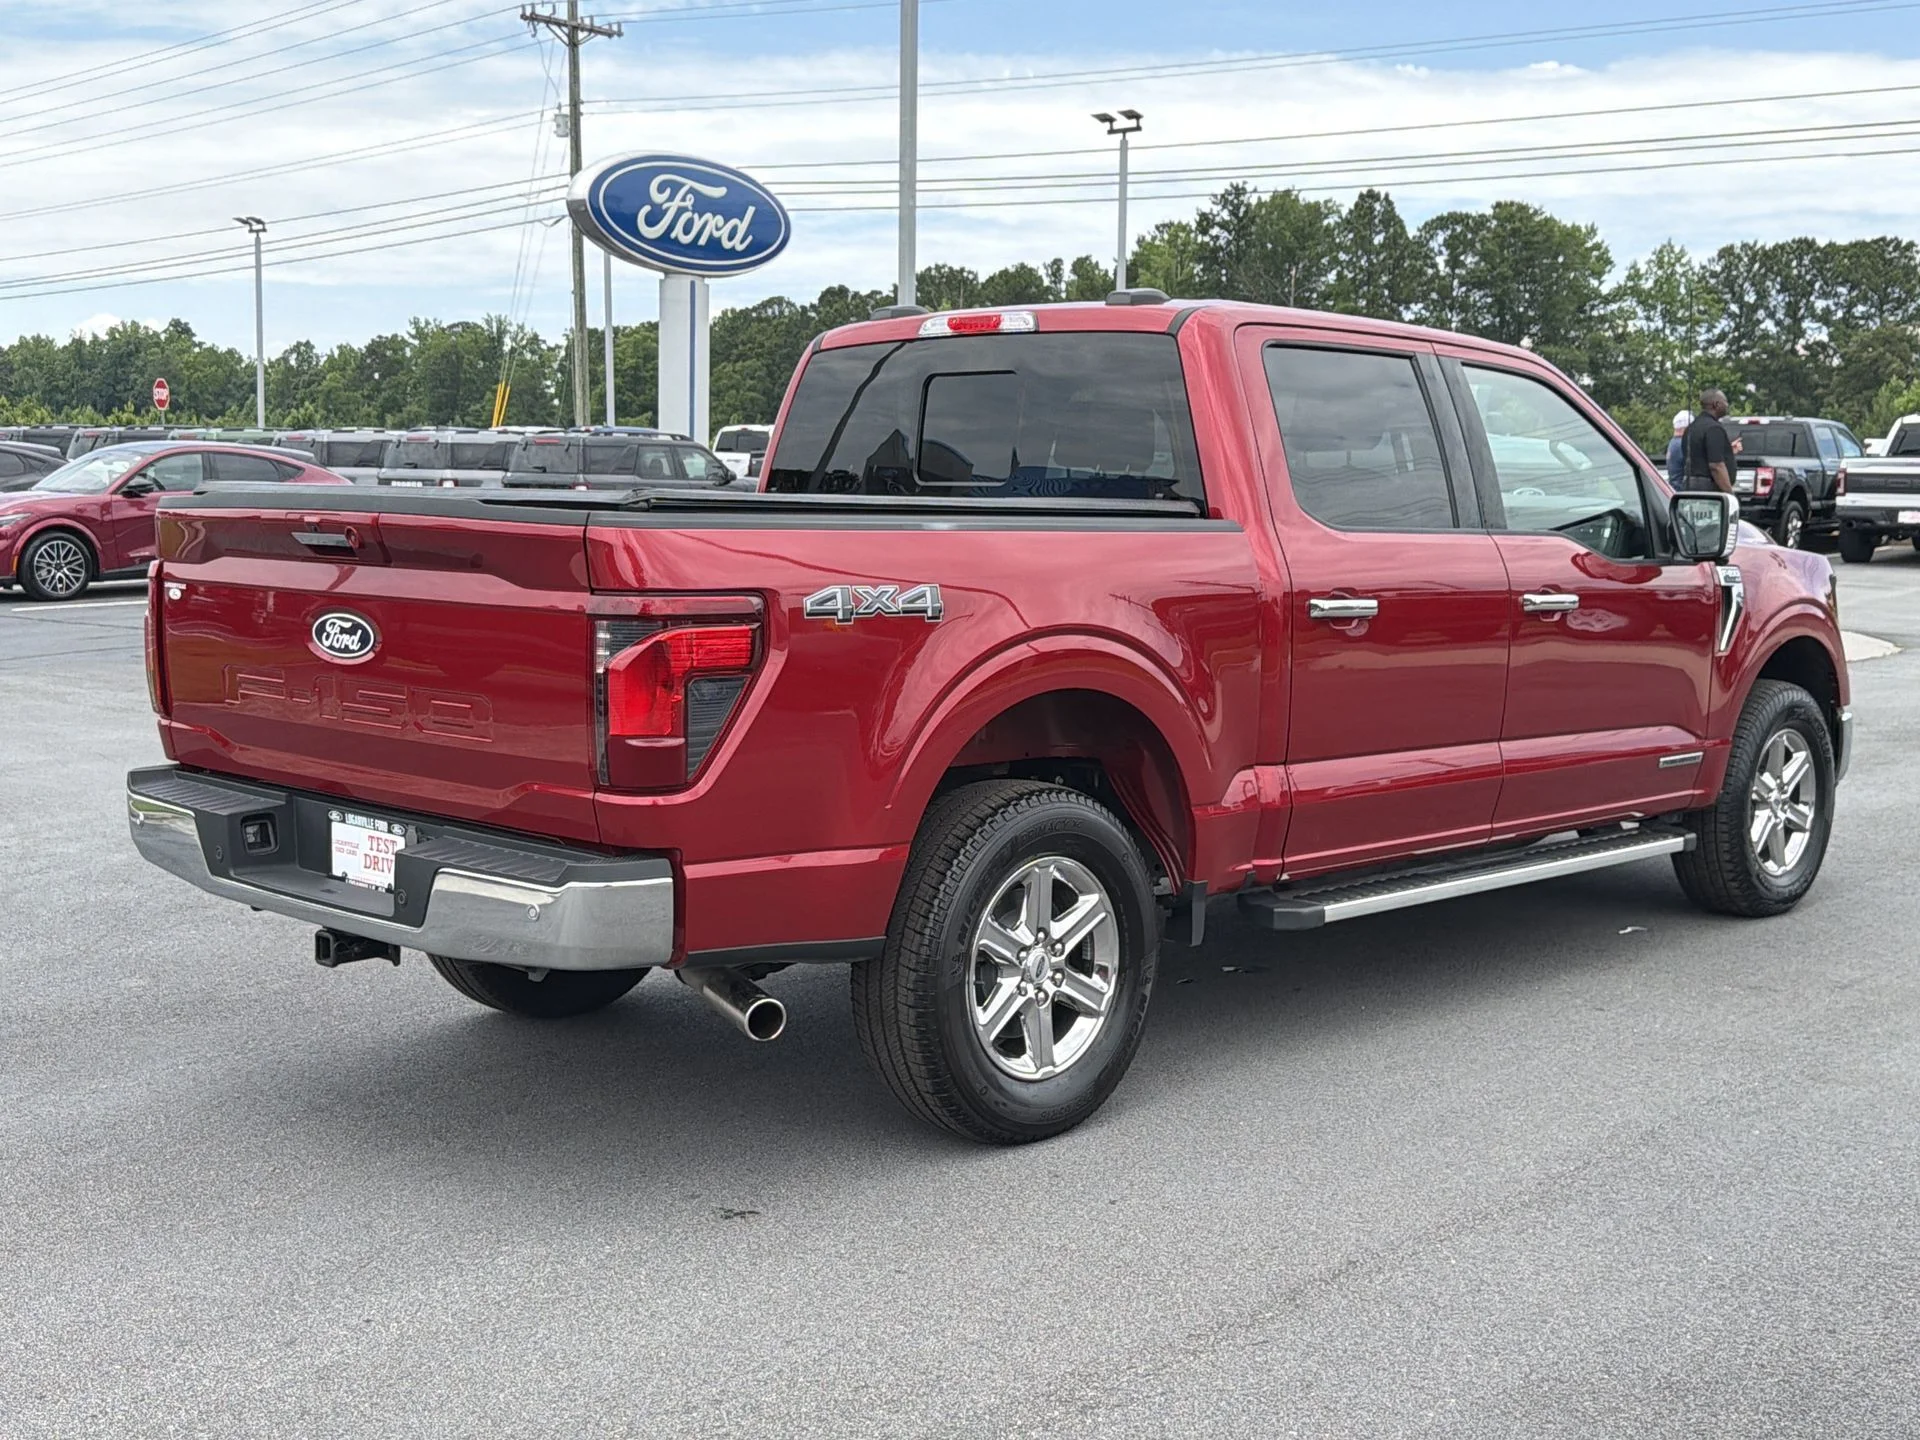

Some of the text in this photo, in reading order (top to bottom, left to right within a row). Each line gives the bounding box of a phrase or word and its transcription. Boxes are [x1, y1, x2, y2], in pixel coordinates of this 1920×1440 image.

[637, 173, 756, 252] Ford
[322, 617, 363, 651] Ford
[223, 663, 494, 743] F-150
[367, 835, 398, 856] TEST
[363, 853, 395, 874] DRIV
